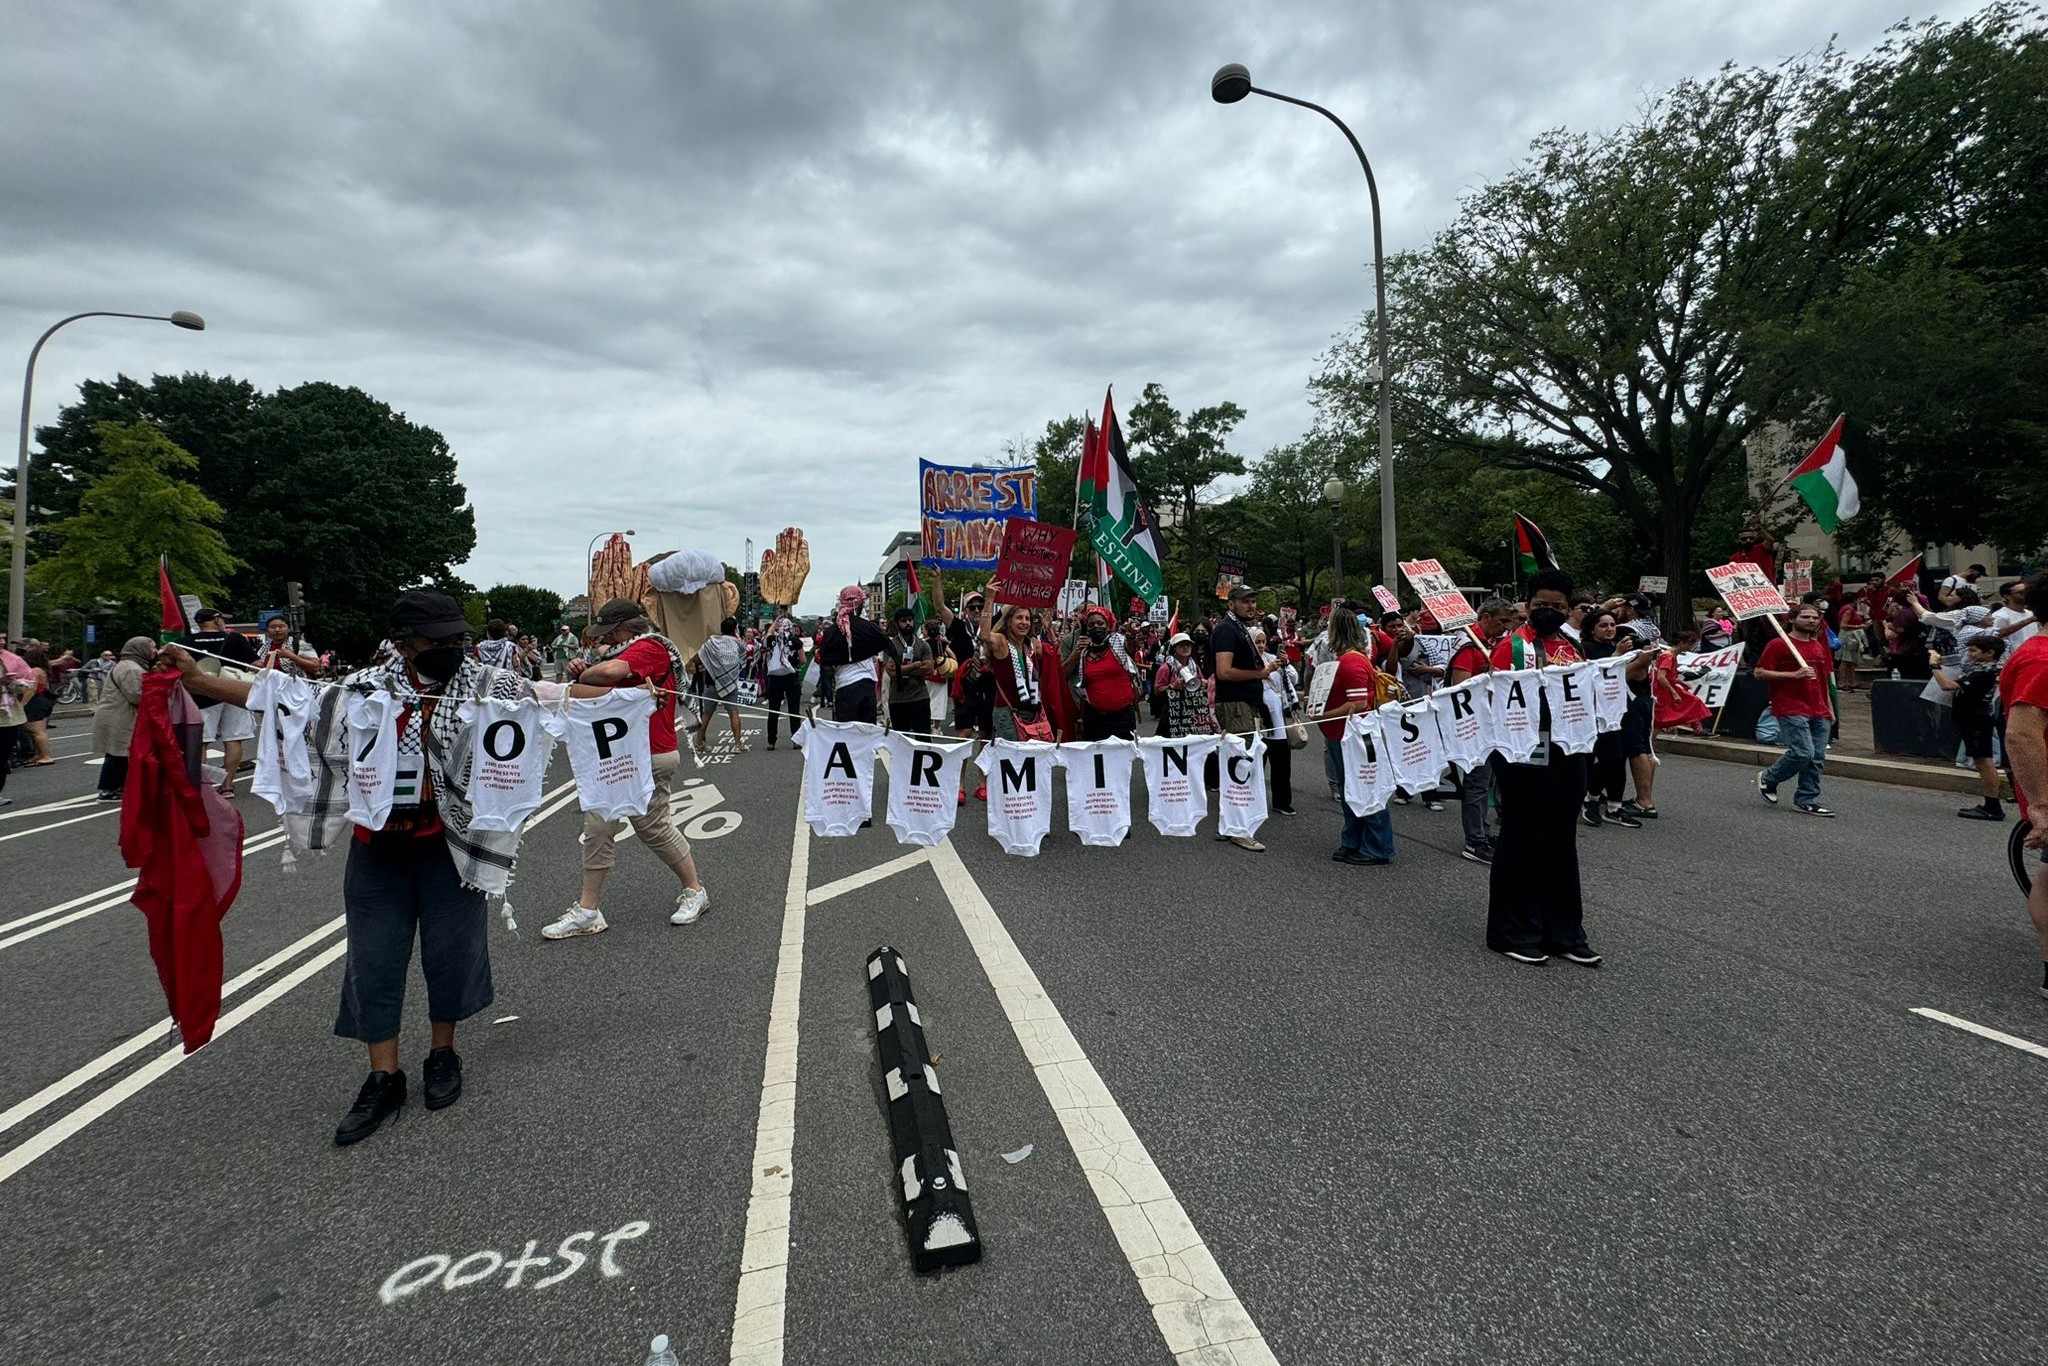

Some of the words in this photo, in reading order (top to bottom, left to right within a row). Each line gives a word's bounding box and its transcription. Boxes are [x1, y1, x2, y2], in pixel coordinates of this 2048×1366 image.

[923, 467, 1035, 513] ARREST
[921, 513, 1009, 562] NETANYA
[1023, 524, 1058, 544] WHY
[1094, 531, 1153, 596] ESTINE
[1402, 560, 1441, 576] WANTED
[1709, 563, 1758, 579] WANTED
[1726, 588, 1777, 604] BENJAMIN
[1732, 598, 1783, 612] NETANYAHU
[1690, 650, 1739, 668] GAZA
[1507, 680, 1526, 709] A
[1562, 672, 1580, 702] E
[1450, 689, 1474, 720] R
[483, 720, 525, 761] O
[591, 717, 629, 760] P
[1401, 713, 1420, 743] S
[823, 742, 857, 779] A
[910, 749, 944, 787] R
[1000, 756, 1036, 794] M
[1094, 754, 1105, 789] I
[1162, 745, 1188, 777] N
